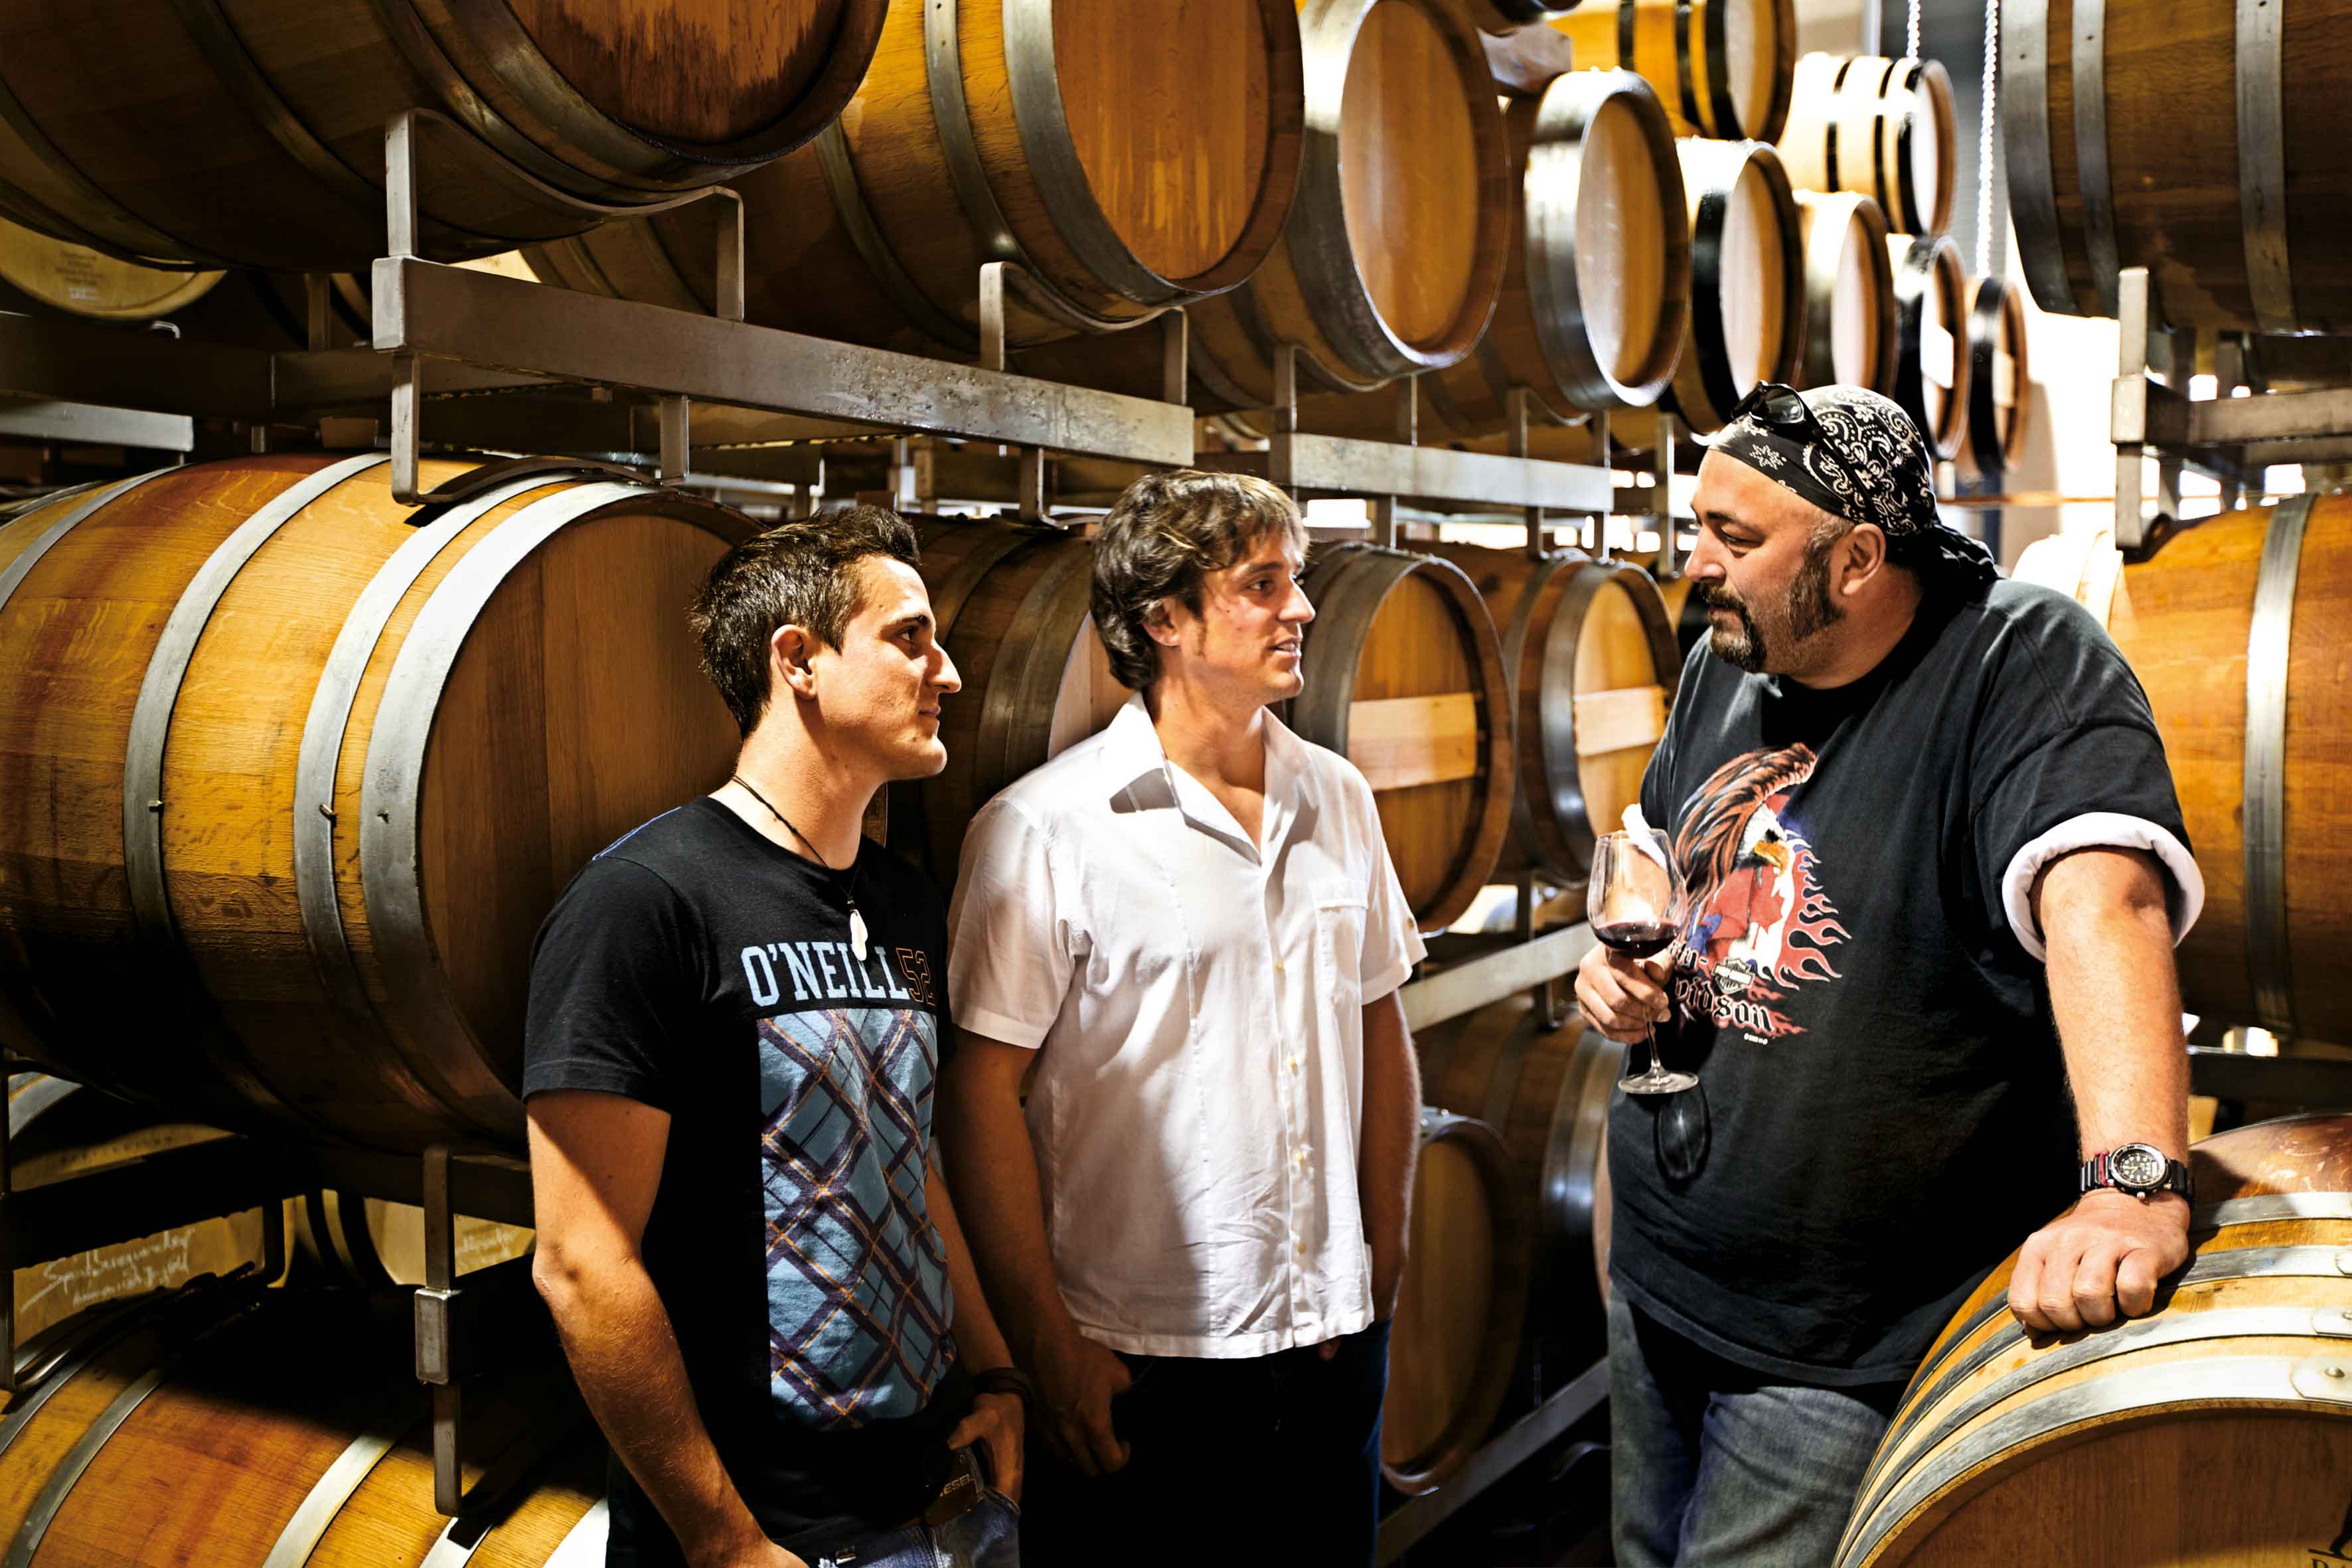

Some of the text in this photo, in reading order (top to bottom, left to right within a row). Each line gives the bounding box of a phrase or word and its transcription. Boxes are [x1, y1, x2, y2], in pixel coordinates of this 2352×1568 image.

[741, 941, 935, 1006] O'NEILL 52
[1675, 977, 1775, 1035] vidson
